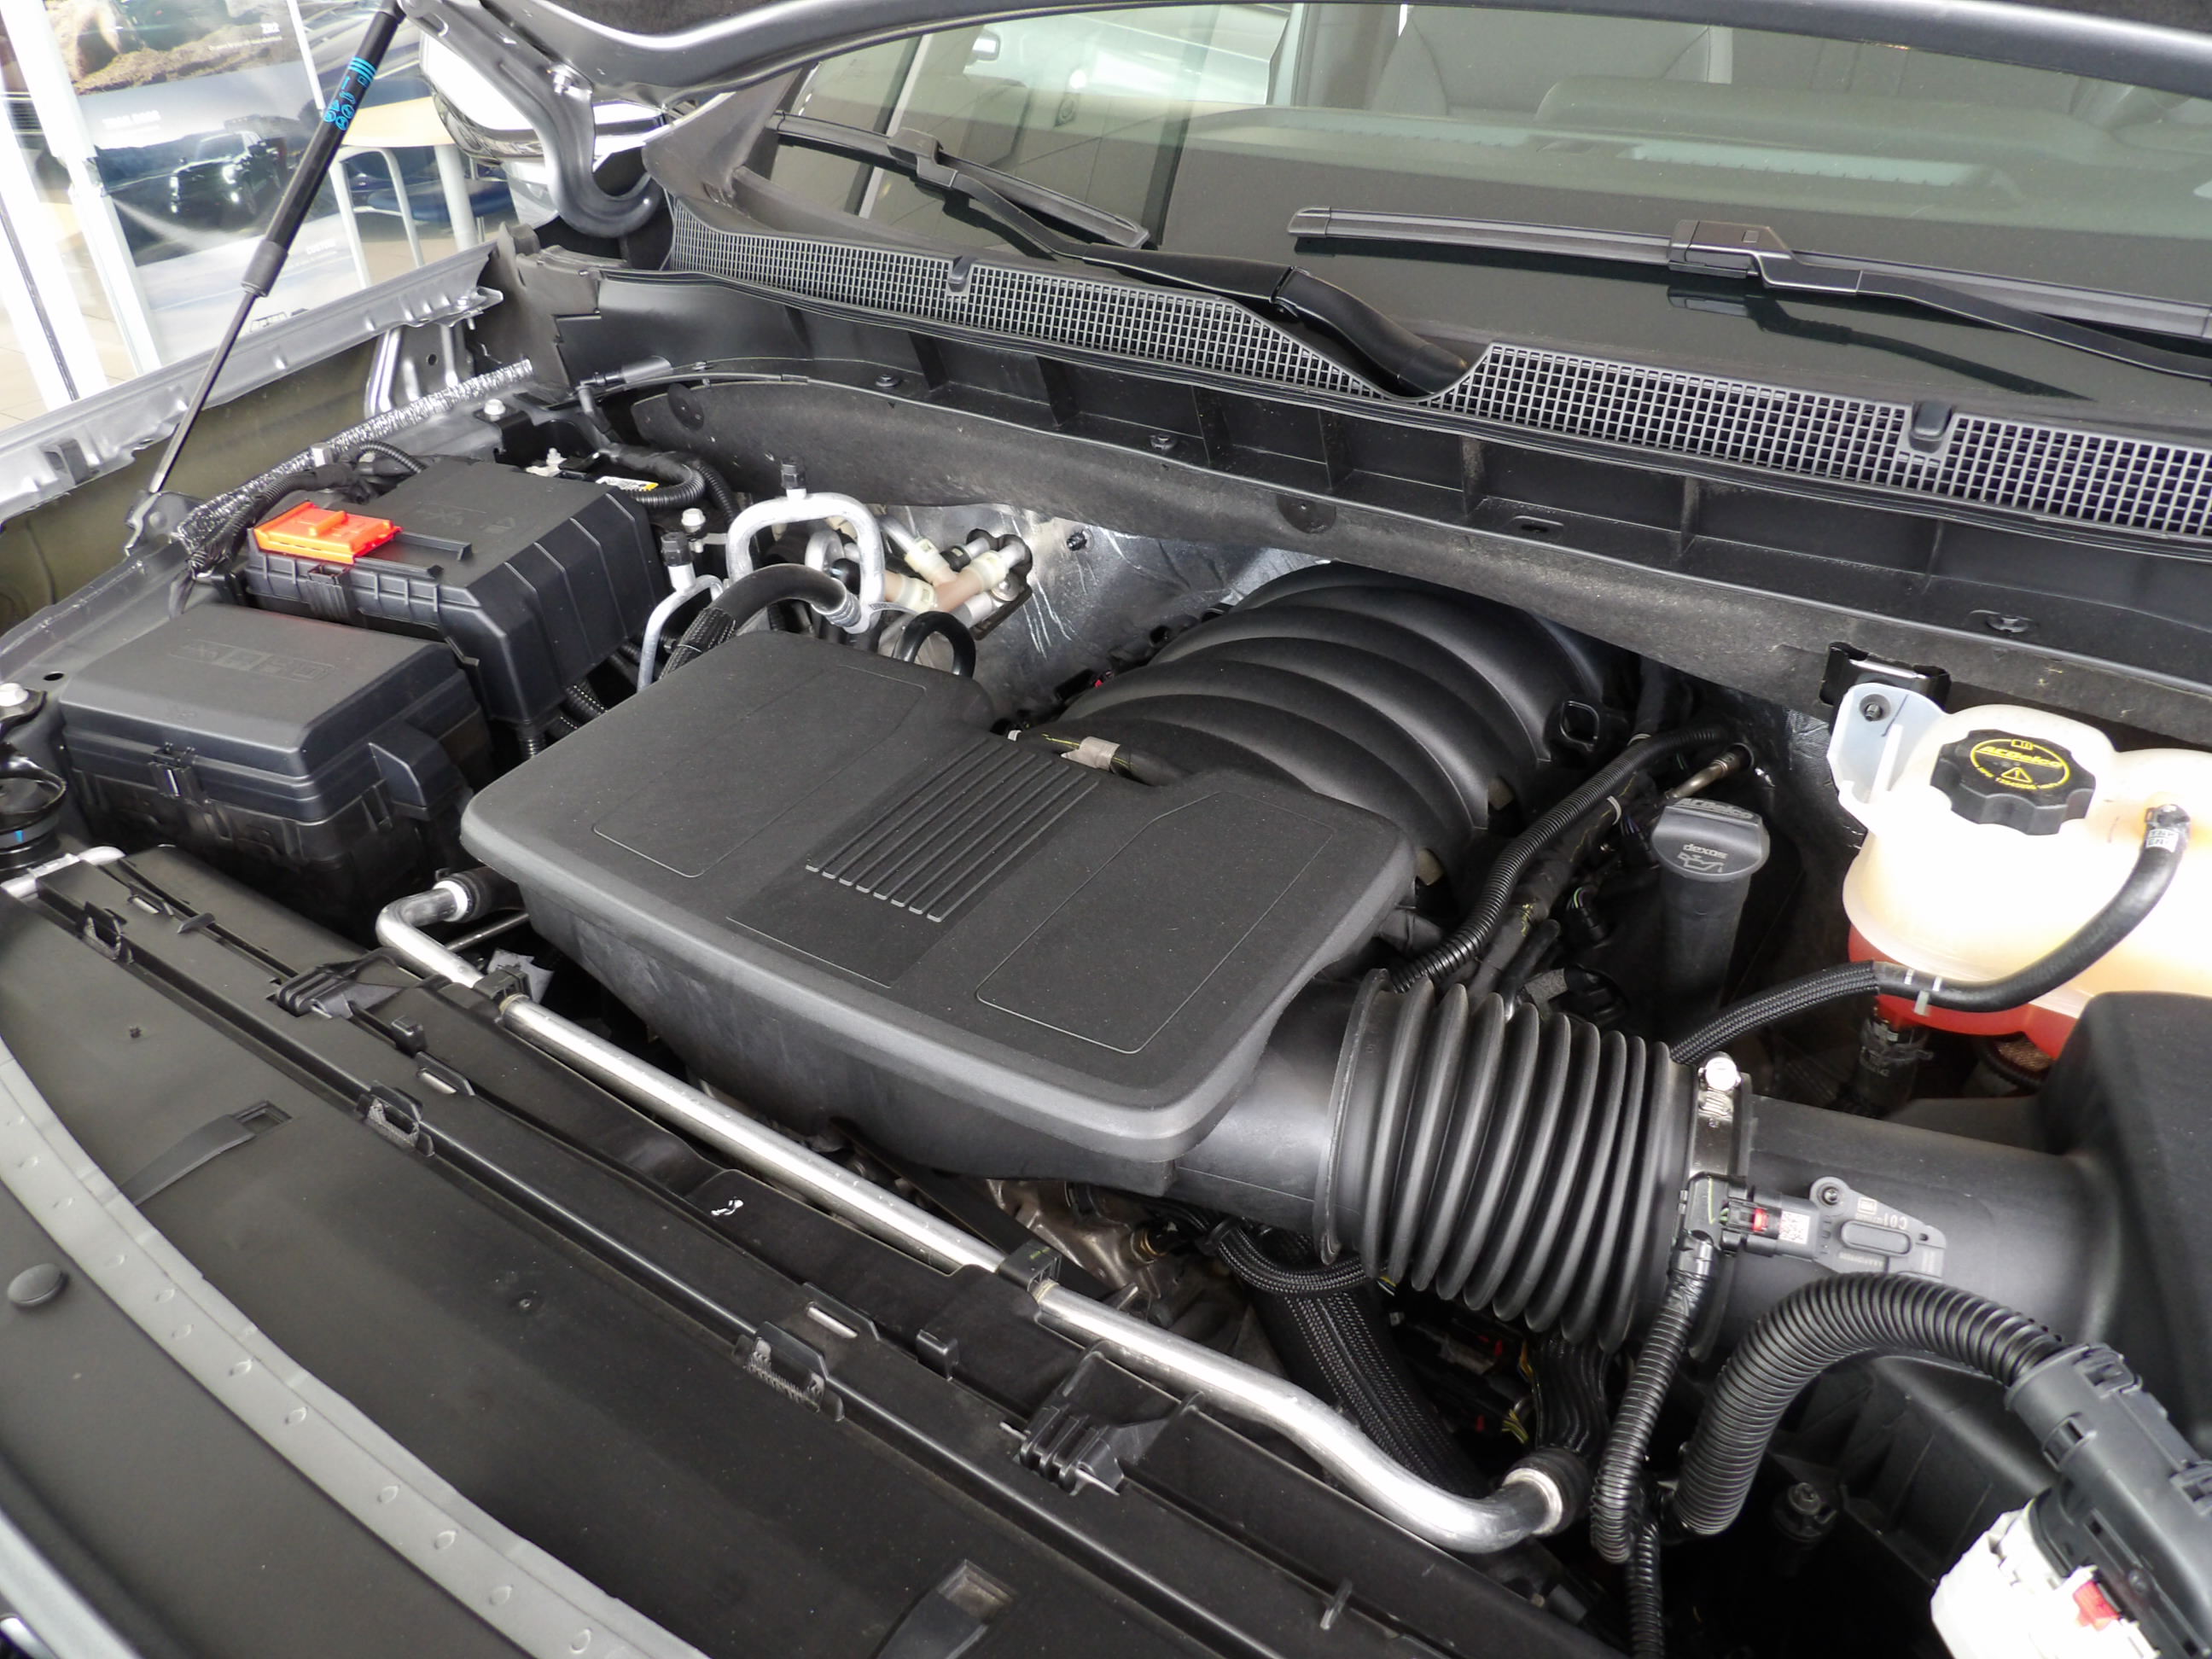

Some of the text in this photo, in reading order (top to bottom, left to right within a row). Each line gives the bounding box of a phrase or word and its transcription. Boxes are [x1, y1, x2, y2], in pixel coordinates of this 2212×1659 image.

[1978, 746, 2064, 768] ACDelco
[1674, 798, 1754, 819] ACDelco
[1683, 843, 1729, 859] dexos
